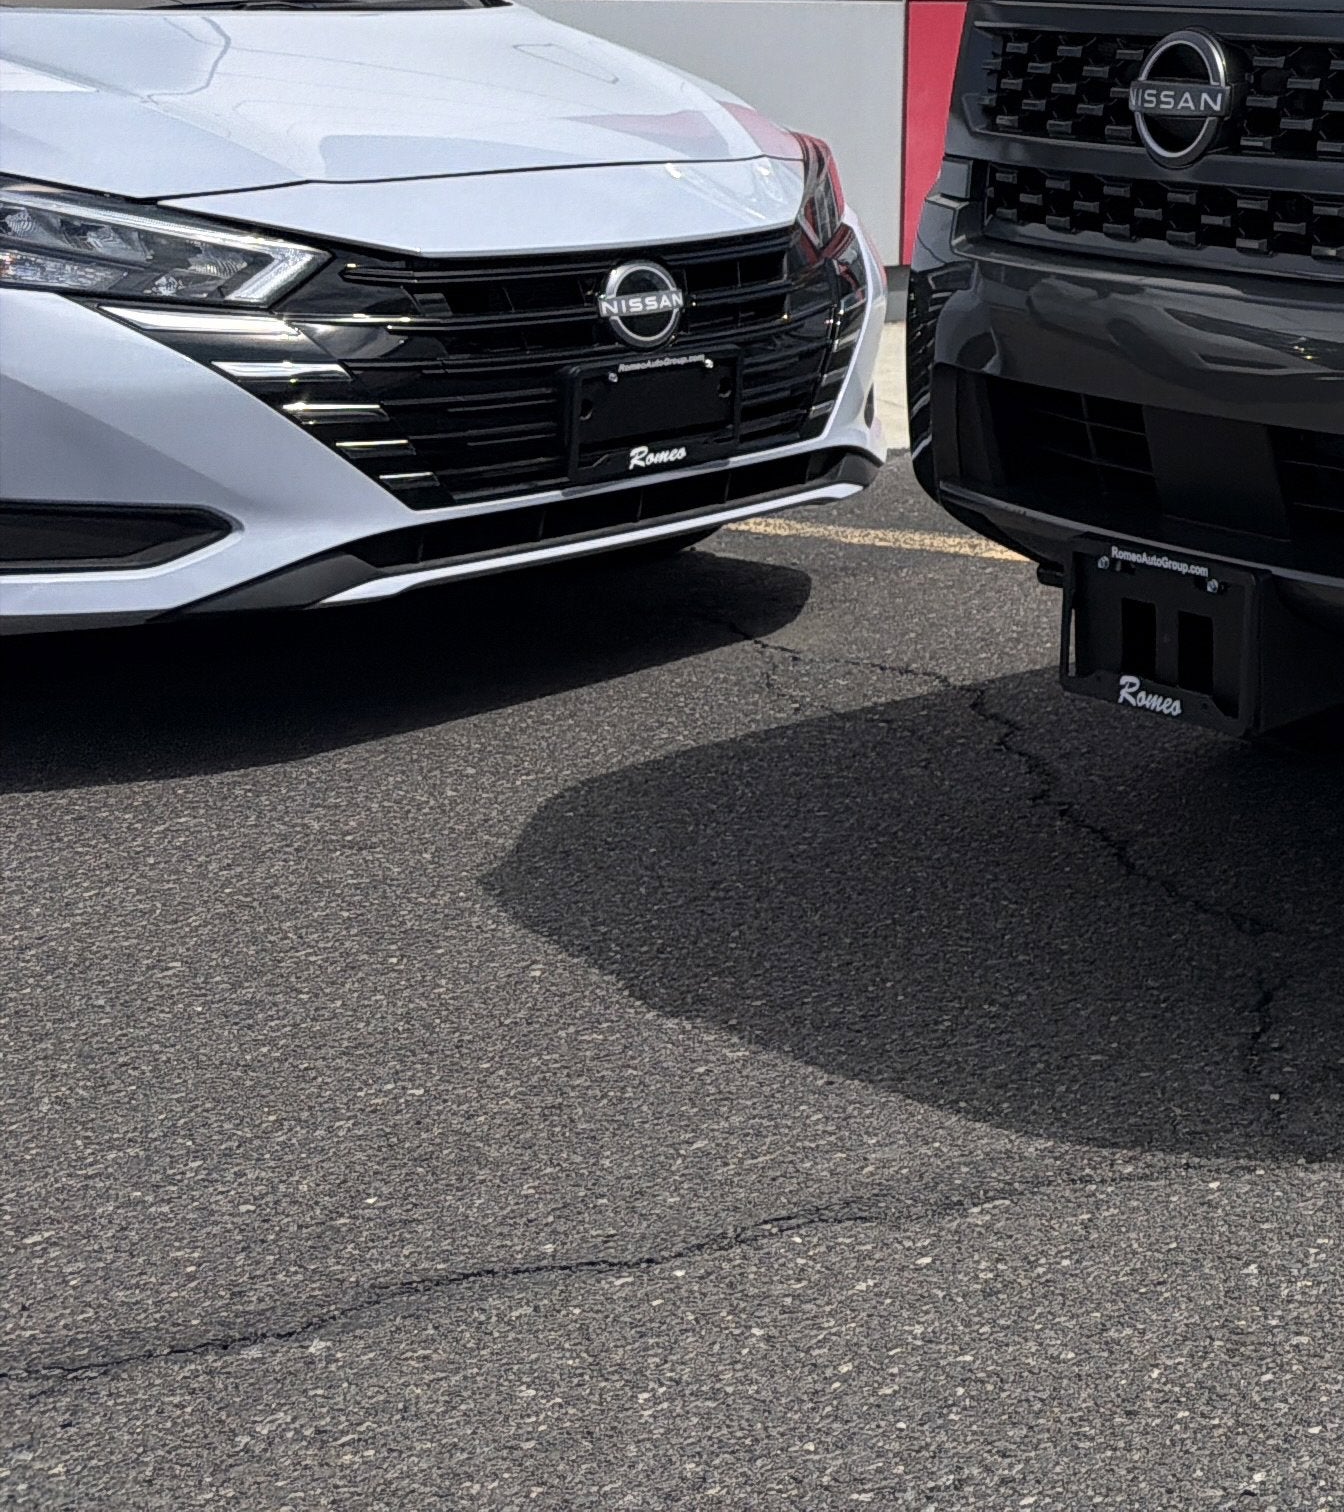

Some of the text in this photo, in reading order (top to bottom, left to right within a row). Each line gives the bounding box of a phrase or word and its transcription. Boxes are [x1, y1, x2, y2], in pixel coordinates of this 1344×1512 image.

[1129, 87, 1222, 112] NISSAN
[601, 293, 684, 315] NISSAN
[628, 446, 687, 470] Romeo
[1111, 545, 1209, 577] RomeoAutoGroup.com
[1117, 675, 1182, 717] Romeo
